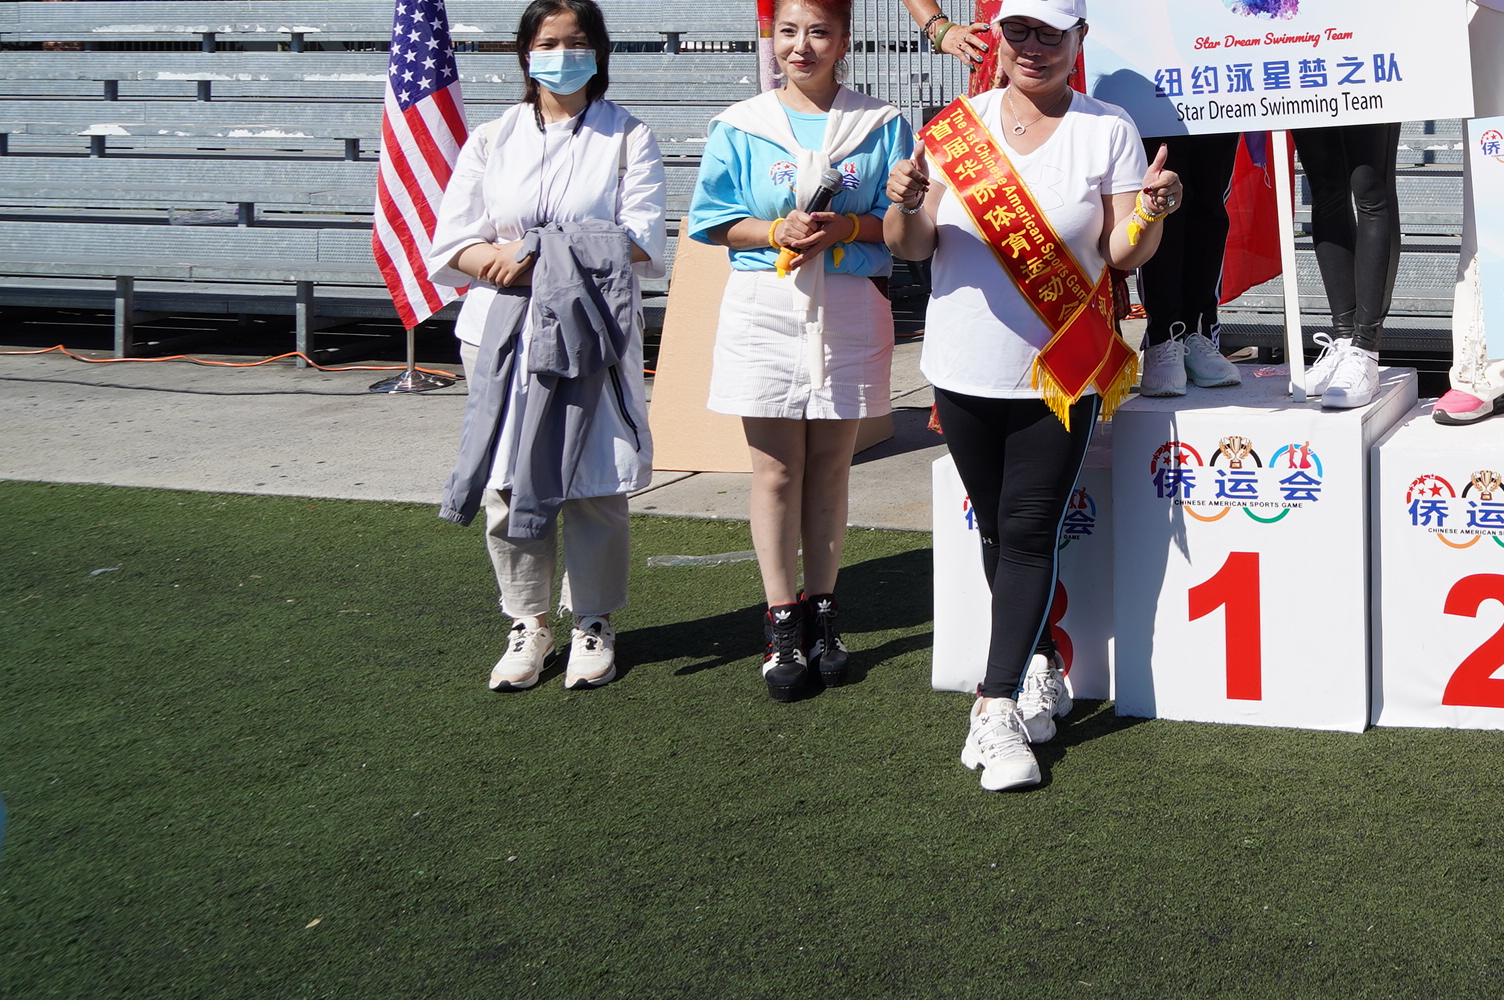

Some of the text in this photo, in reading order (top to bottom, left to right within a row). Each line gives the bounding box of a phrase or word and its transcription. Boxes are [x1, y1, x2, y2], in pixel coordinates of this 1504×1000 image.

[1193, 27, 1354, 51] Star Dream Swimming Team
[1153, 52, 1403, 99] 纽约泳星梦之队
[1176, 91, 1384, 123] Star Dream Swimming Team
[949, 107, 1088, 303] The 1st Chinese American Sports Gam
[1152, 467, 1323, 503] 侨运会
[1173, 499, 1304, 509] CHINESE AMERICAN SPORTS GAME
[1427, 527, 1458, 535] CHINESE
[1460, 528, 1497, 536] AMERICAN
[1187, 551, 1262, 701] 1
